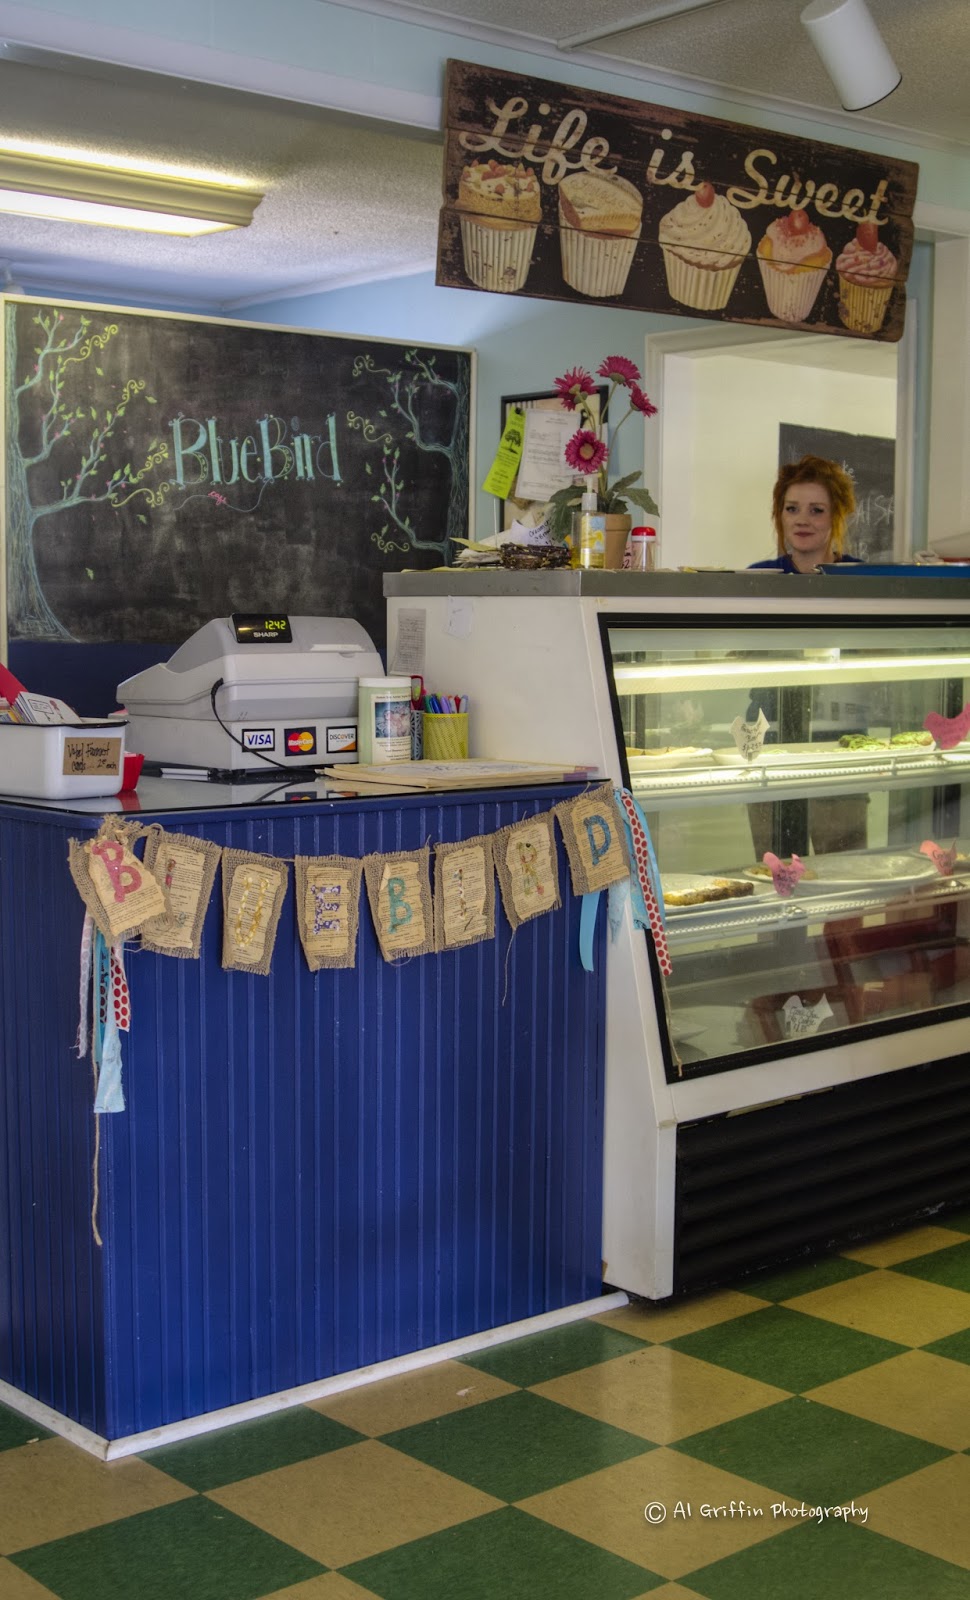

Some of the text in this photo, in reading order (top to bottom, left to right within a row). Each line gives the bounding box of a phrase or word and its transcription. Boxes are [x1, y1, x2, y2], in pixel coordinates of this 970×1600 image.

[459, 97, 889, 225] Life is Sweet
[246, 734, 272, 745] VISA
